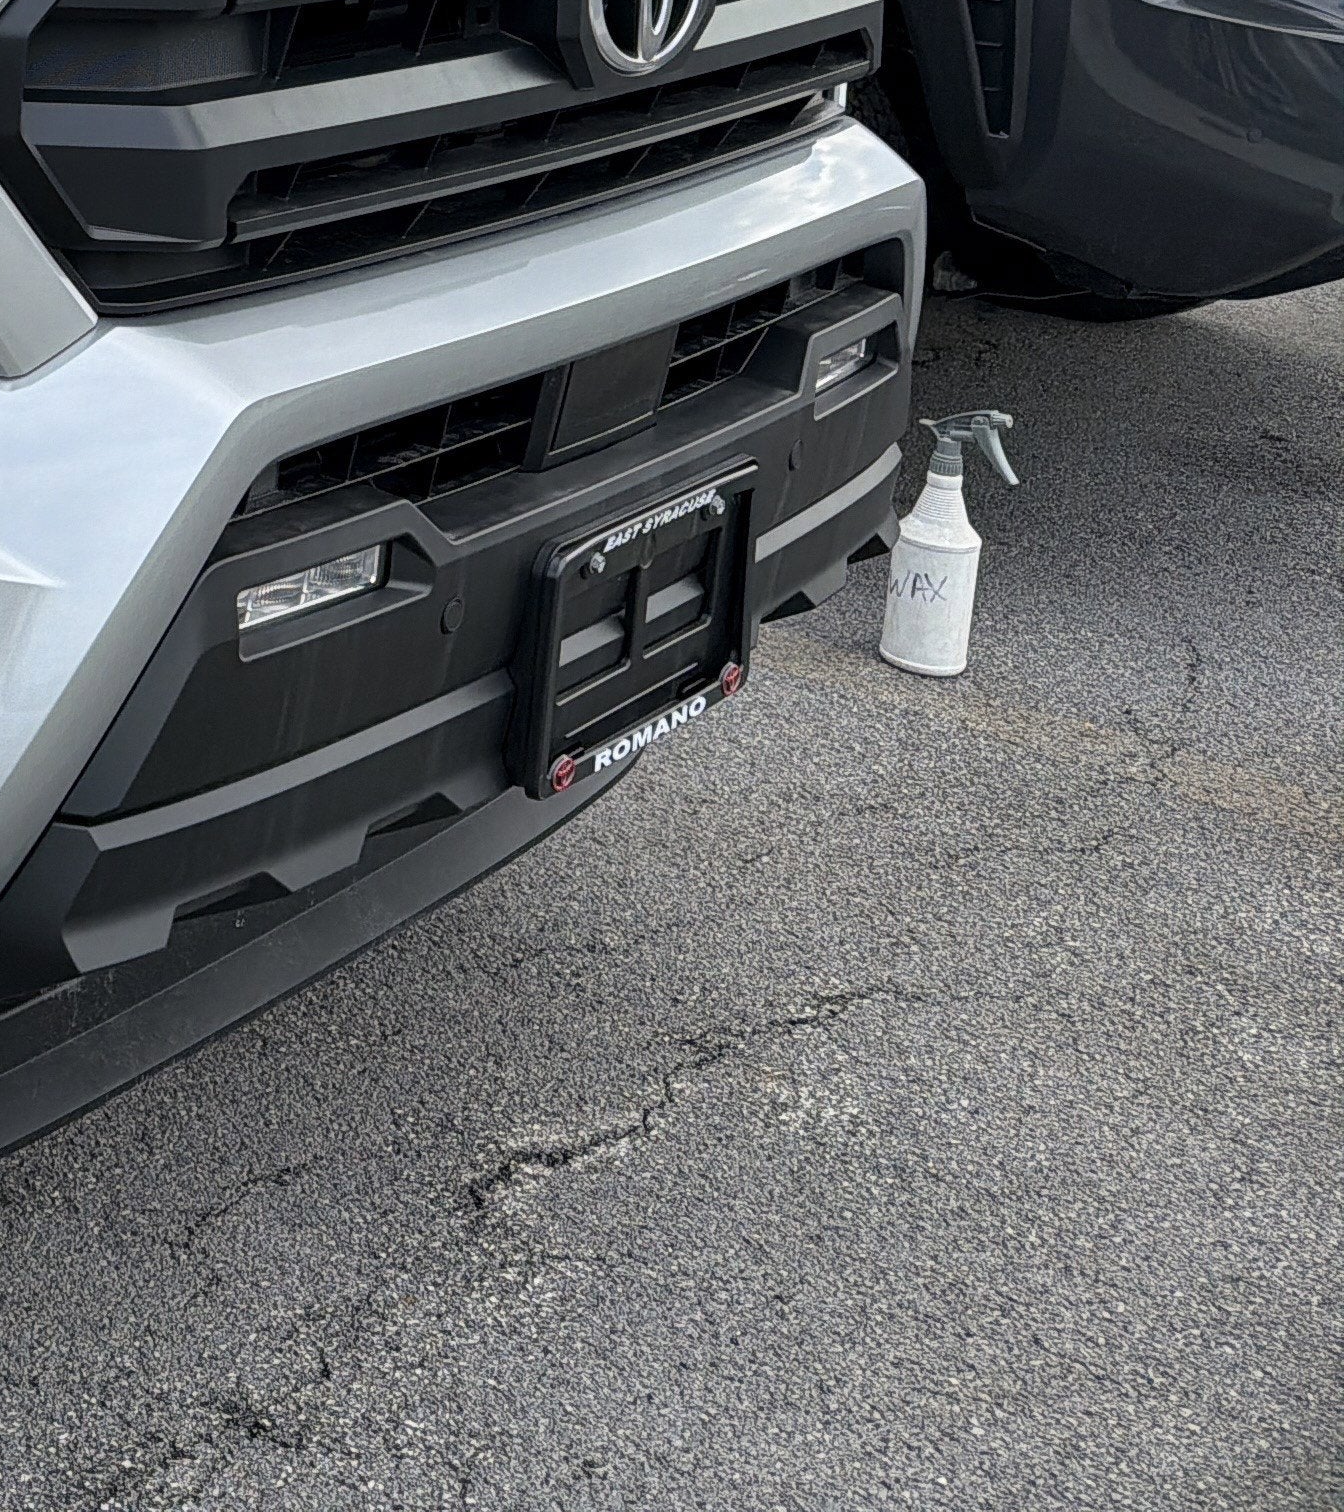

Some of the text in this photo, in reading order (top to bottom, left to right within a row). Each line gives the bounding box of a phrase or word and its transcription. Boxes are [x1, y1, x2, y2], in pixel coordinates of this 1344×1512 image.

[603, 488, 717, 553] EAST SYRACUSE
[889, 569, 948, 603] WAX
[594, 696, 707, 773] ROMANO
